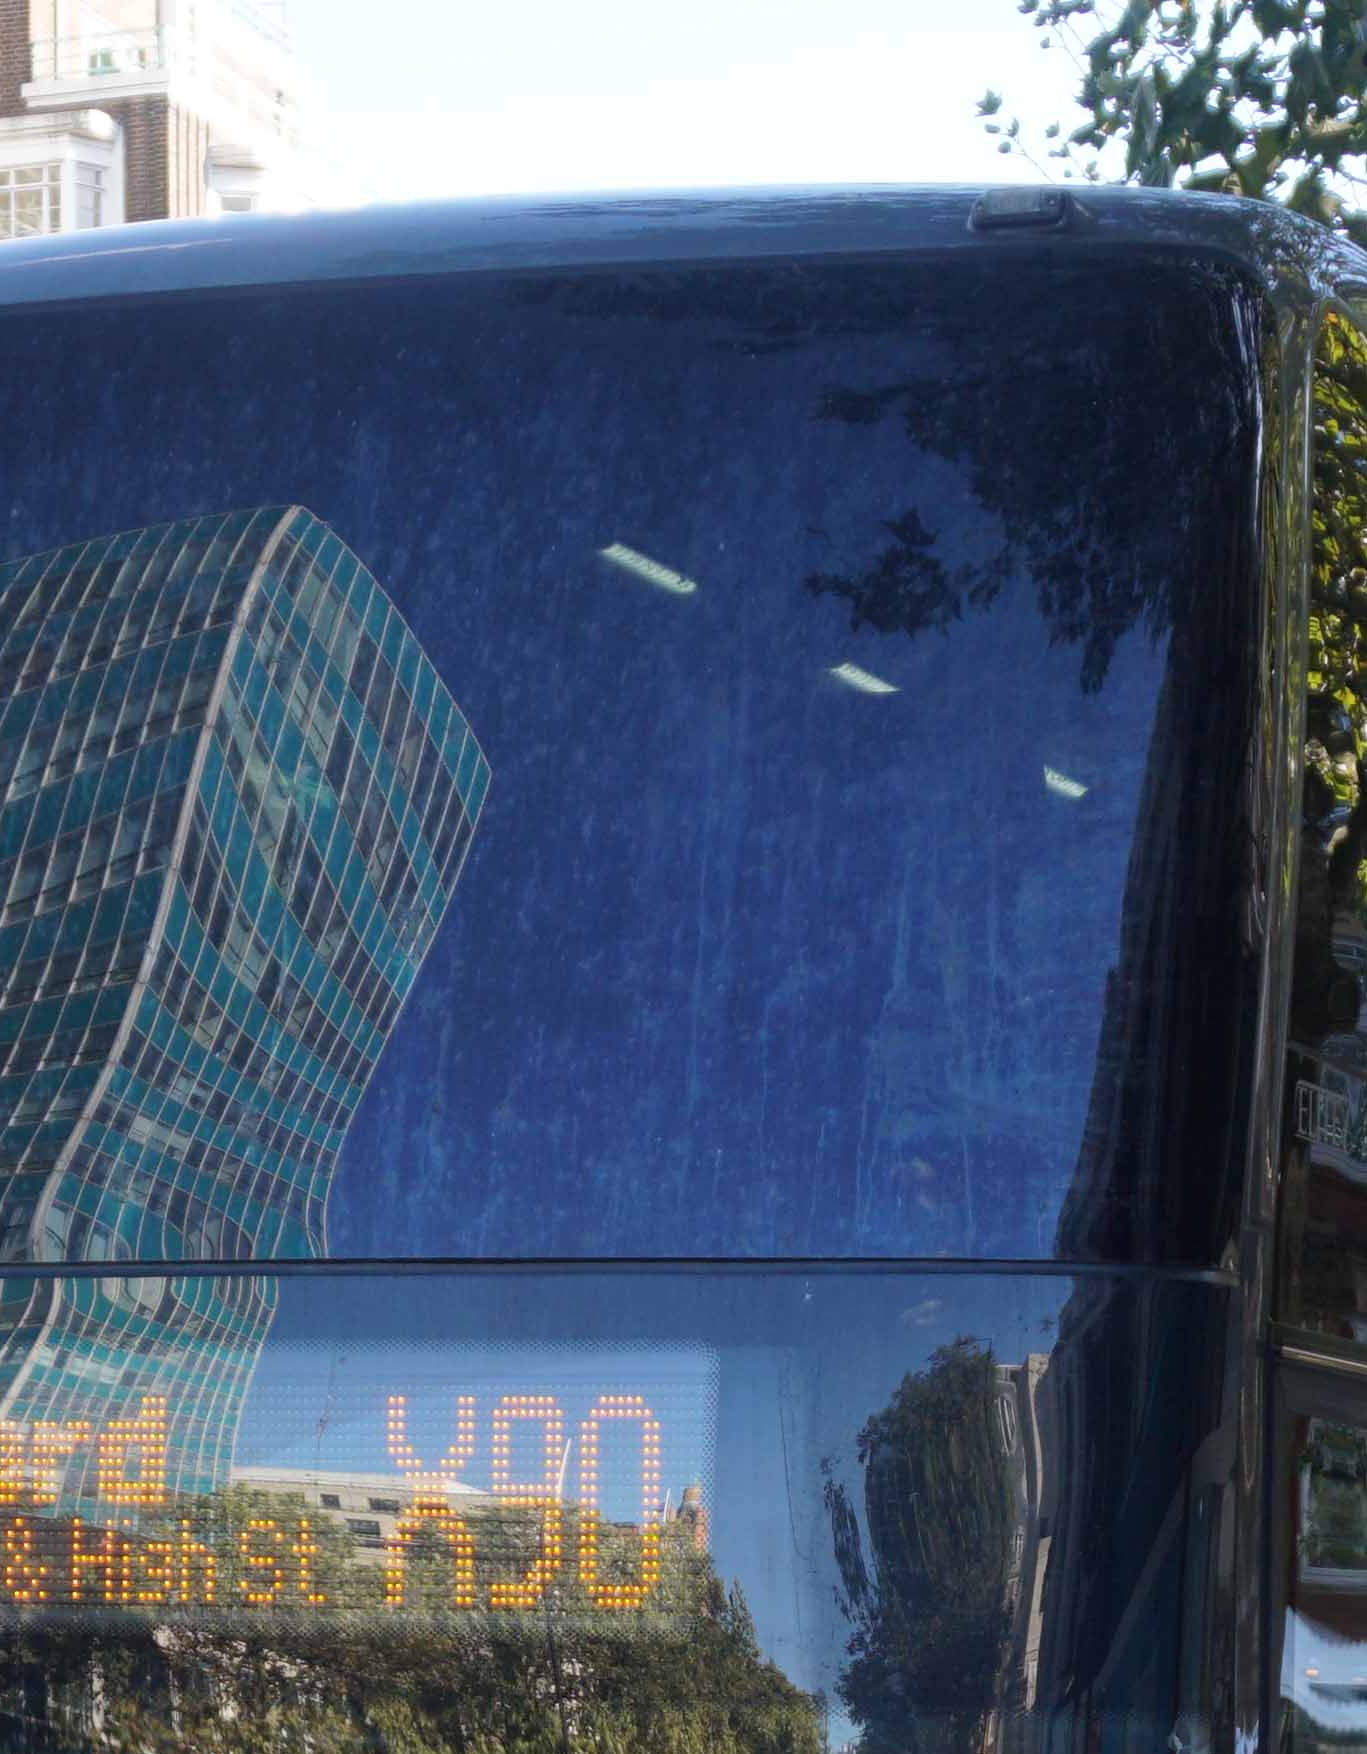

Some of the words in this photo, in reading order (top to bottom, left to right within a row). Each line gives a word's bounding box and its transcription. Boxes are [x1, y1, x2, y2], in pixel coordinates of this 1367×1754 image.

[72, 1519, 215, 1602] High
[249, 1520, 326, 1604] St
[384, 1395, 662, 1609] X90
